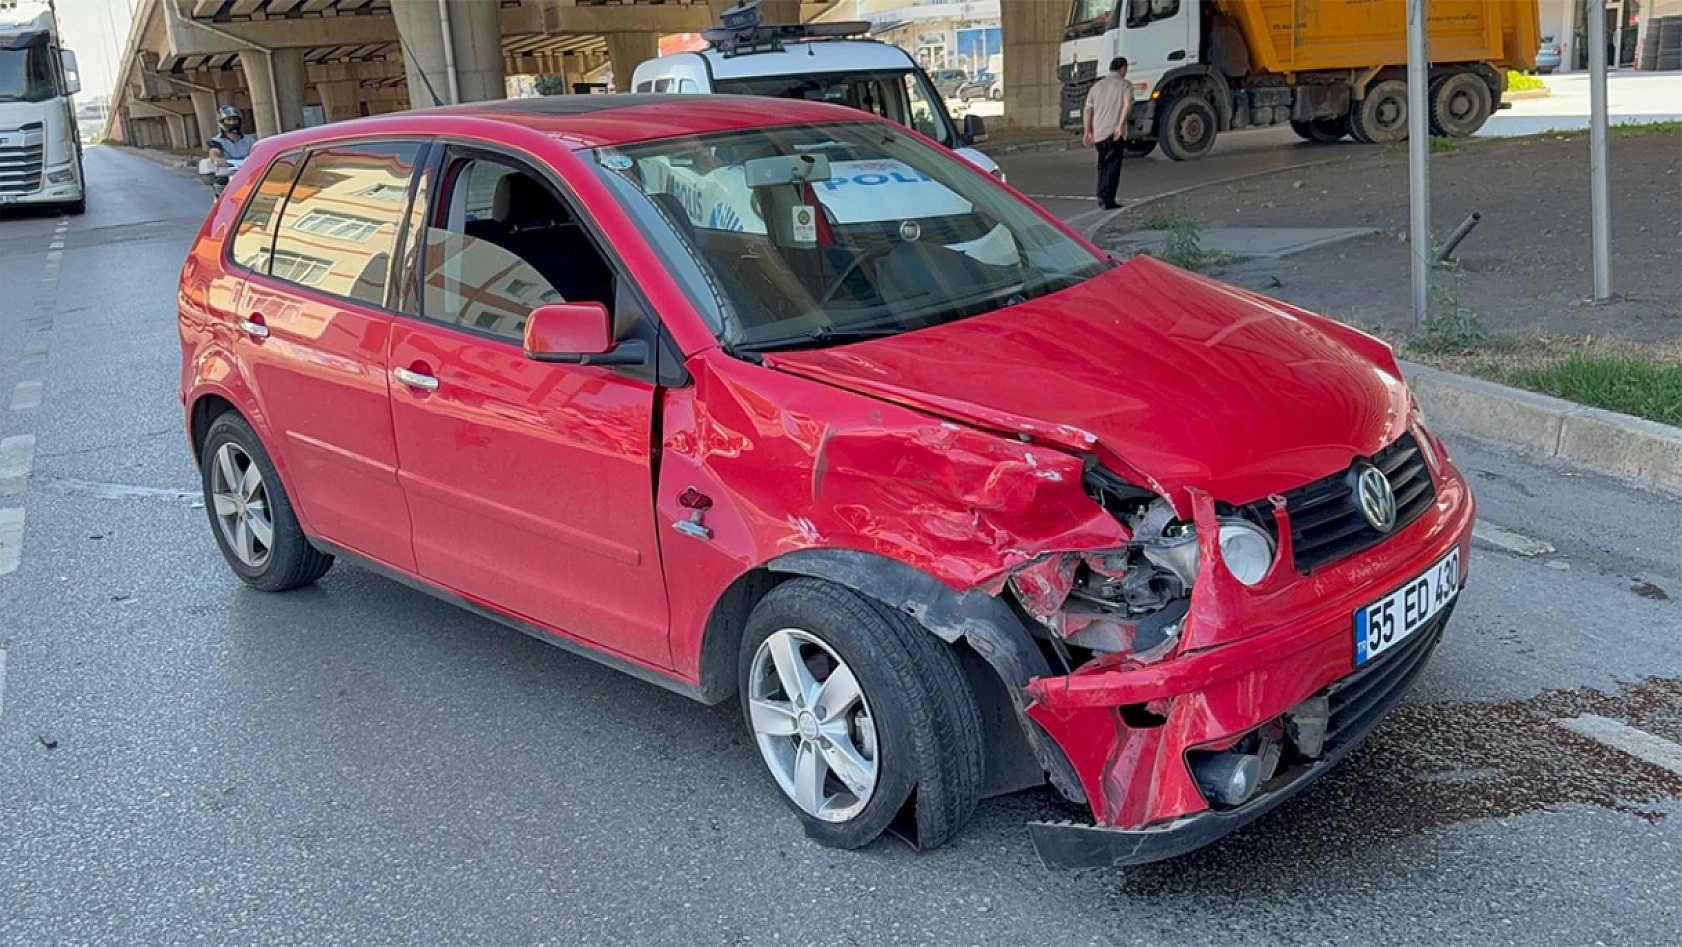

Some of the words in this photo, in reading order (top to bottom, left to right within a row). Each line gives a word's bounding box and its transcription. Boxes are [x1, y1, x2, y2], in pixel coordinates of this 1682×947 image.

[823, 169, 932, 190] POLI
[1369, 599, 1395, 651] 55
[1405, 578, 1429, 631] ED
[1435, 554, 1459, 605] 430
[1356, 640, 1368, 655] TR
